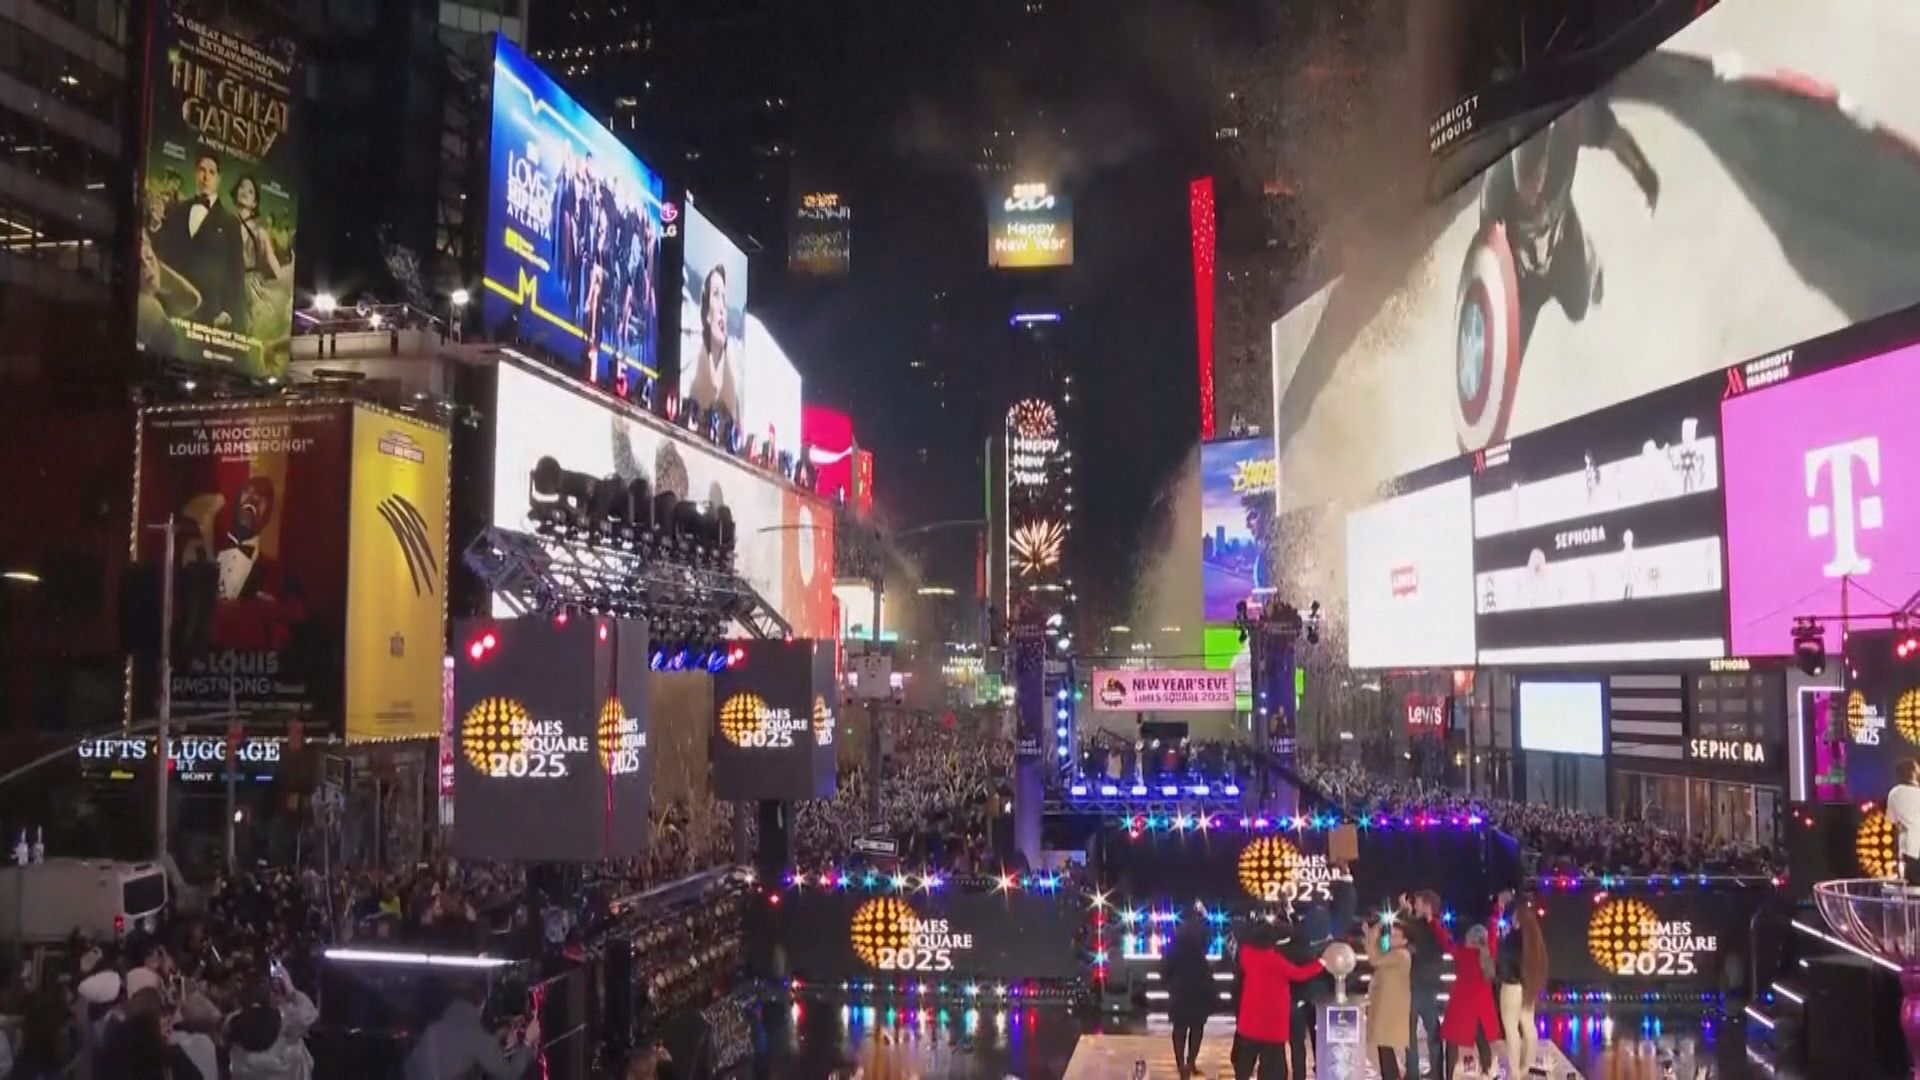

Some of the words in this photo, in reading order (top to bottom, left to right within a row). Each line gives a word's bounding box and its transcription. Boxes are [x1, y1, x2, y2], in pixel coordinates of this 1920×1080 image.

[1430, 95, 1479, 137] MARRIOTT
[182, 98, 278, 157] GATSBY
[1431, 115, 1473, 152] MARQUIS
[1008, 223, 1055, 238] Happy
[995, 238, 1028, 252] New
[1032, 238, 1067, 252] Year
[211, 426, 291, 441] KNOCKOUT
[169, 443, 210, 456] LOUIS
[213, 438, 315, 455] ARMSTRONG!"
[1013, 437, 1060, 454] Happy
[1013, 454, 1045, 468] New
[1555, 524, 1606, 551] SEPHORA
[208, 651, 279, 674] LOUIS
[1709, 657, 1751, 672] SEPHORA
[172, 677, 271, 694] RMSTRONG
[1132, 677, 1160, 691] NEW
[1161, 677, 1206, 691] YEAR'S
[1207, 677, 1229, 690] EVE
[1164, 691, 1200, 704] SQUARE
[1201, 691, 1229, 702] 2025
[754, 706, 791, 720] TIMES
[510, 718, 564, 736] TIMES
[760, 718, 809, 733] SQUARE
[78, 738, 147, 760] GIFTS
[520, 735, 589, 756] SQUARE
[1690, 738, 1765, 763] SEPHORA
[611, 748, 640, 775] 2025
[181, 773, 213, 782] SONY
[1282, 853, 1328, 868] TIMES
[1290, 867, 1341, 883] SQUAR
[897, 917, 949, 934] TIMES
[1637, 920, 1692, 936] TIMES
[907, 933, 973, 951] SQUARE
[1648, 935, 1718, 954] SQUARE
